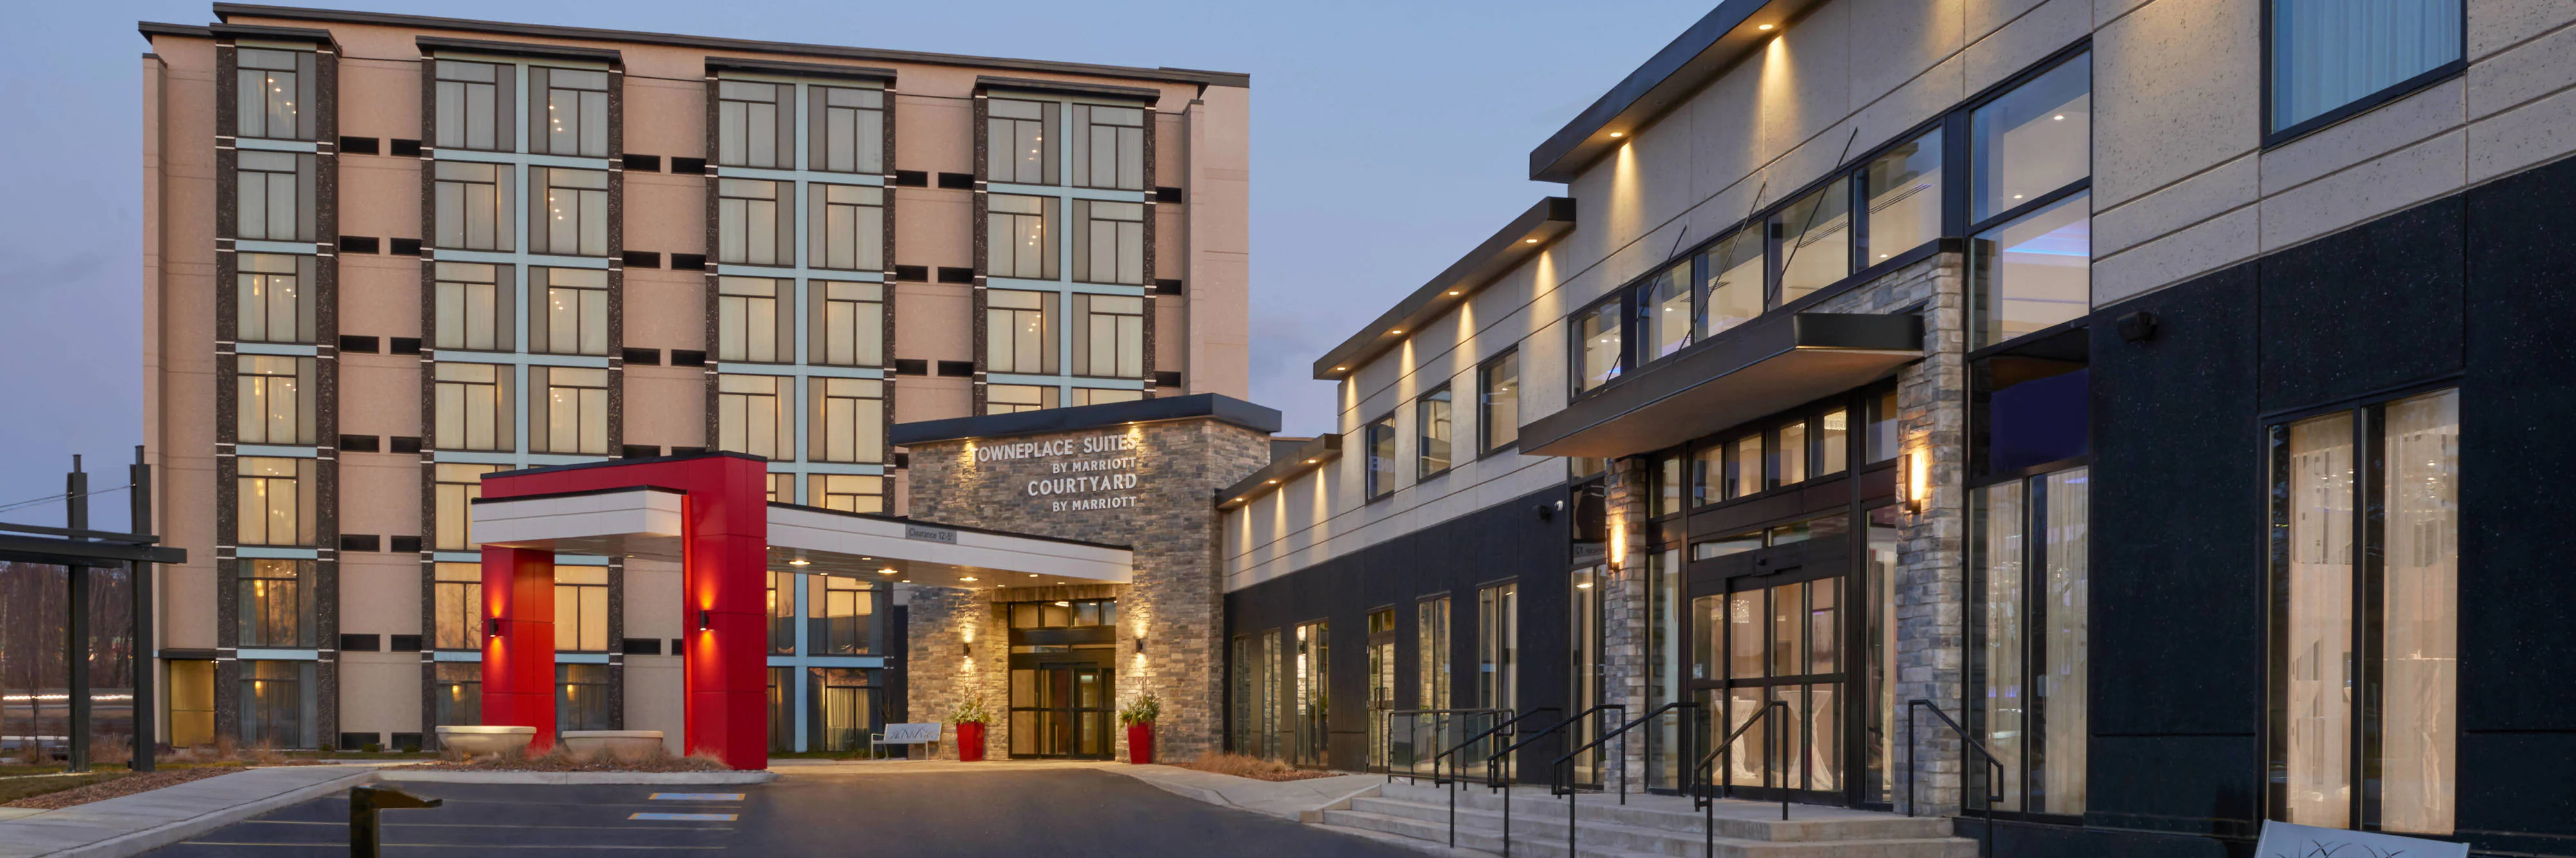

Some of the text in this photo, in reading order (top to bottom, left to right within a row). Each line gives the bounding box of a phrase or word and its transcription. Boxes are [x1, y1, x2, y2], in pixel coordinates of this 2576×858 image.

[971, 433, 1137, 463] TOWNEPLACE SUITES
[1052, 457, 1137, 474] BY MARRIOTT
[1028, 473, 1137, 497] COURTYARD
[1052, 496, 1137, 512] BY MARRIOTT
[909, 528, 937, 539] Clearance
